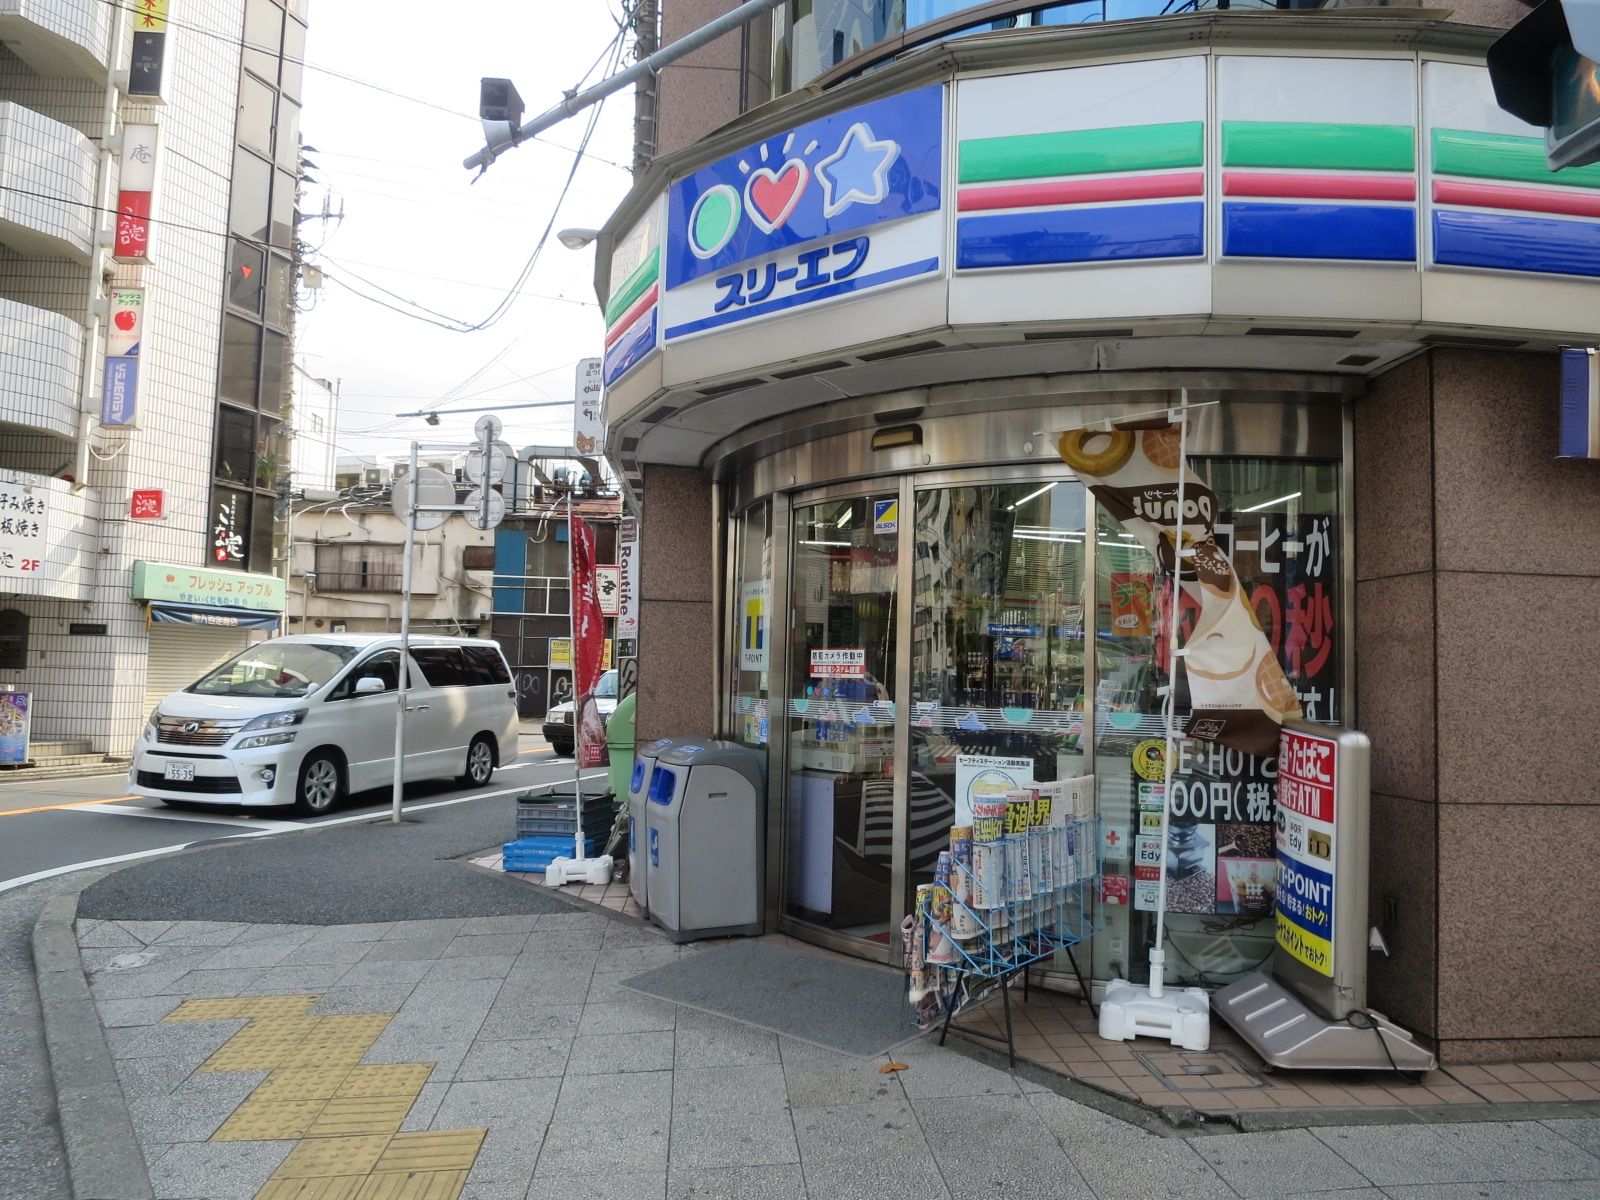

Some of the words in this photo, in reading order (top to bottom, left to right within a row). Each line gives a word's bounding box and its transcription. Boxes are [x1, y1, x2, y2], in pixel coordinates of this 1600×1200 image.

[714, 236, 869, 312] スリーエフ
[1213, 516, 1330, 577] コーヒーが
[20, 559, 40, 571] 2F
[189, 575, 233, 592] フレッシュ
[238, 580, 272, 597] アップル
[812, 652, 863, 660] 防犯カメラ作動中
[1141, 850, 1161, 861] Edy
[1289, 834, 1302, 852] Edy
[1309, 838, 1330, 857] iD
